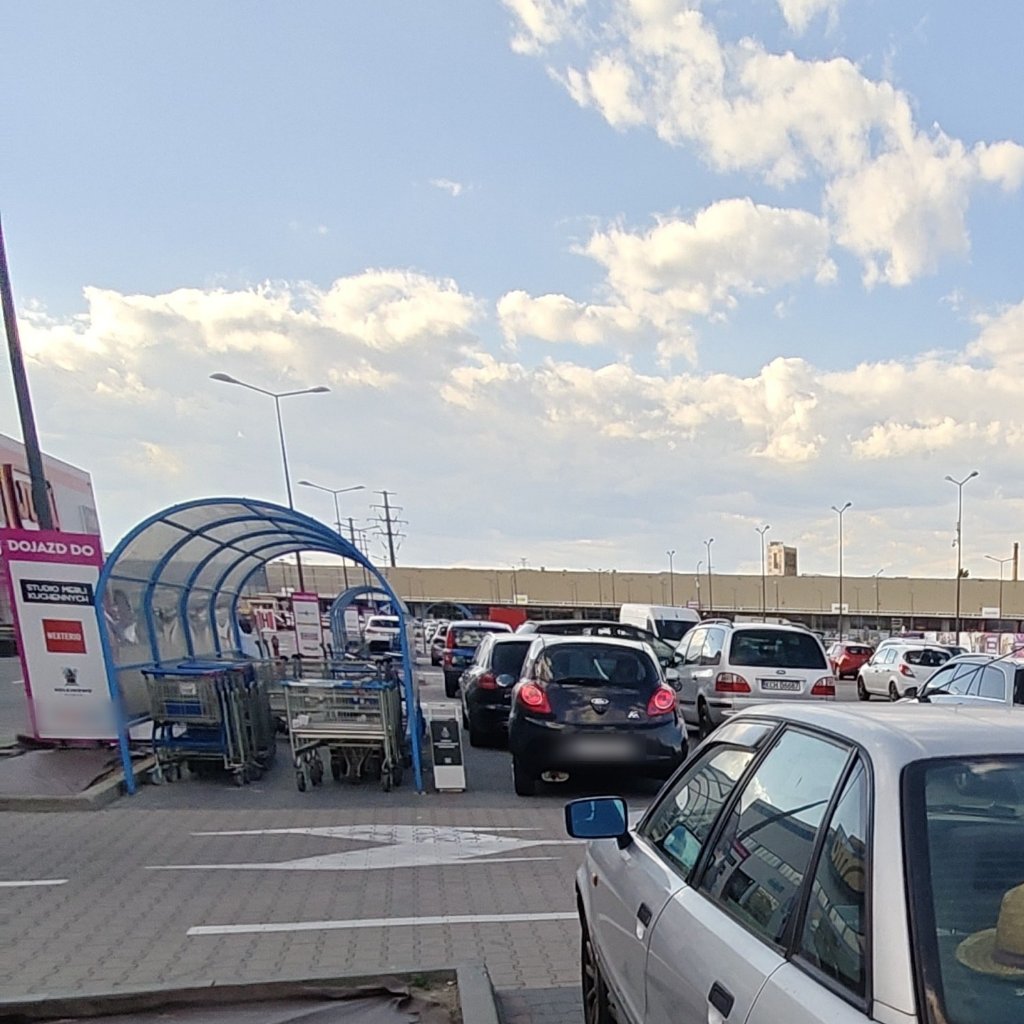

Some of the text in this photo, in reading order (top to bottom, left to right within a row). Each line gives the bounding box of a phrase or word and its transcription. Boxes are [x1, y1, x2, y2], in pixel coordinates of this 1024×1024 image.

[7, 540, 94, 556] DOJAZD DO
[26, 584, 59, 593] STUDIO
